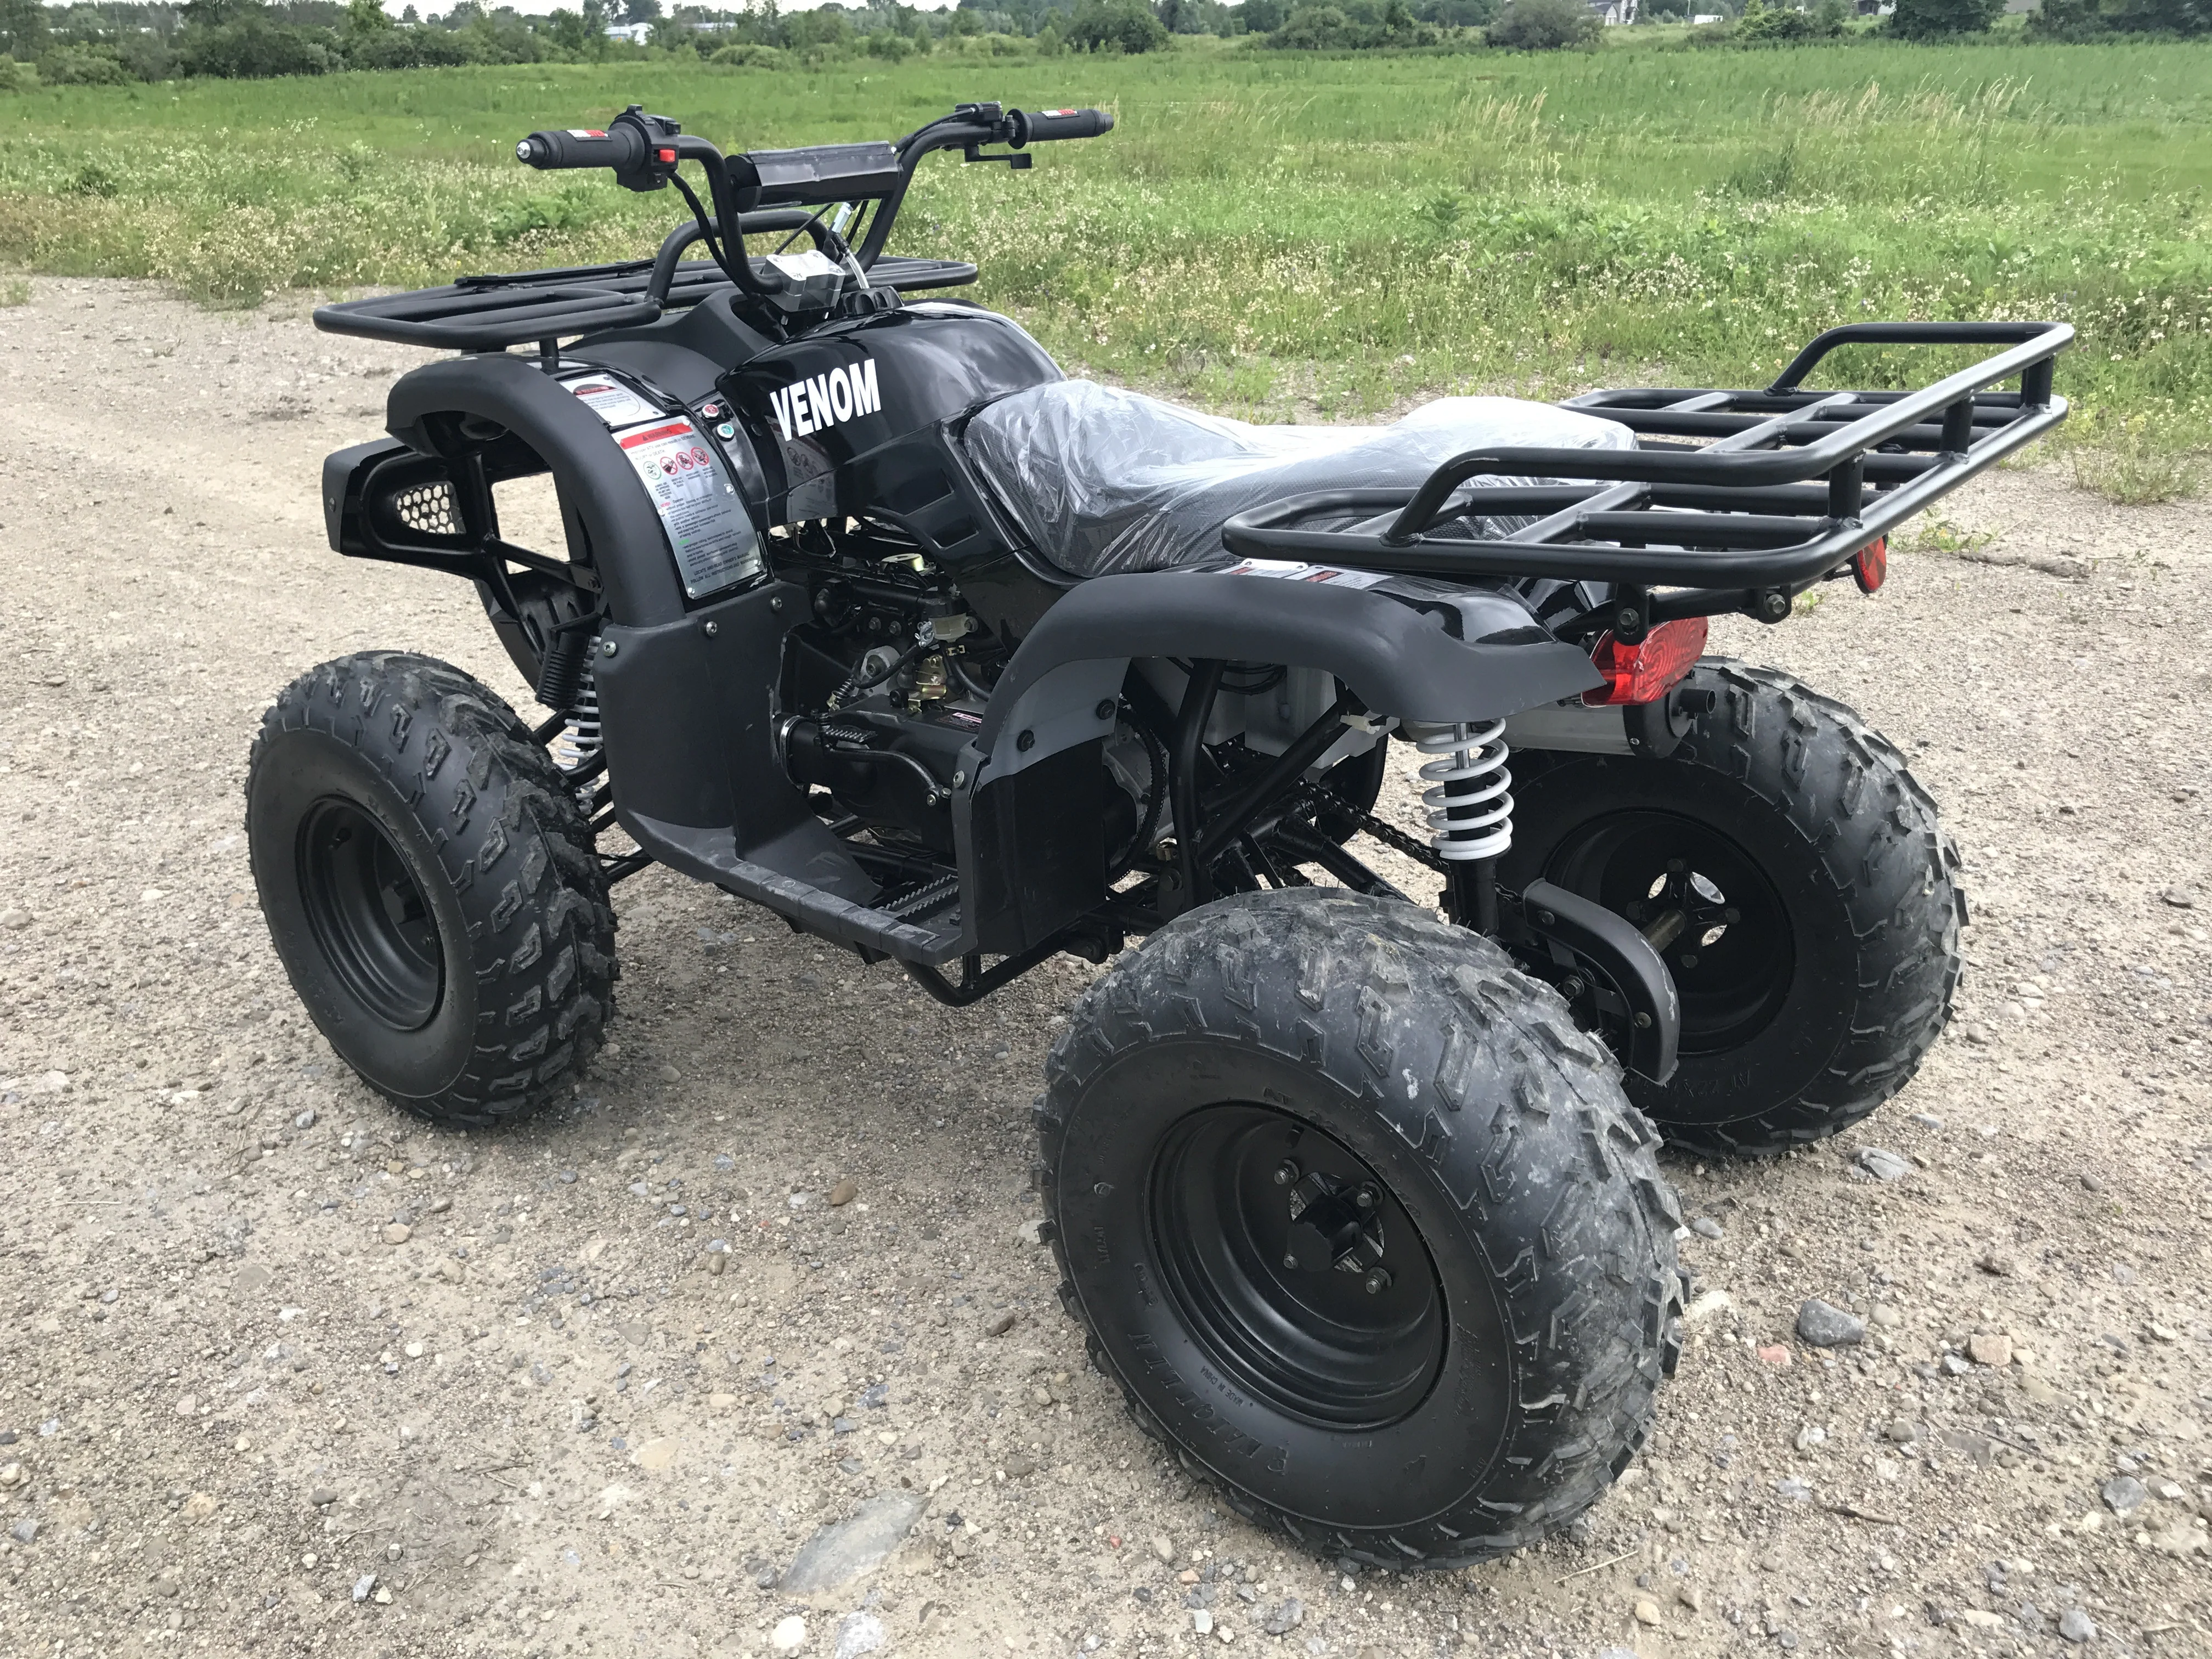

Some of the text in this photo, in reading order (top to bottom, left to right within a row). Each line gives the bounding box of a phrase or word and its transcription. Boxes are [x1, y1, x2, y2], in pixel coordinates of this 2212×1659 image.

[769, 358, 881, 442] VENOM
[1199, 1365, 1219, 1386] CHINA
[1224, 1387, 1244, 1407] MADE
